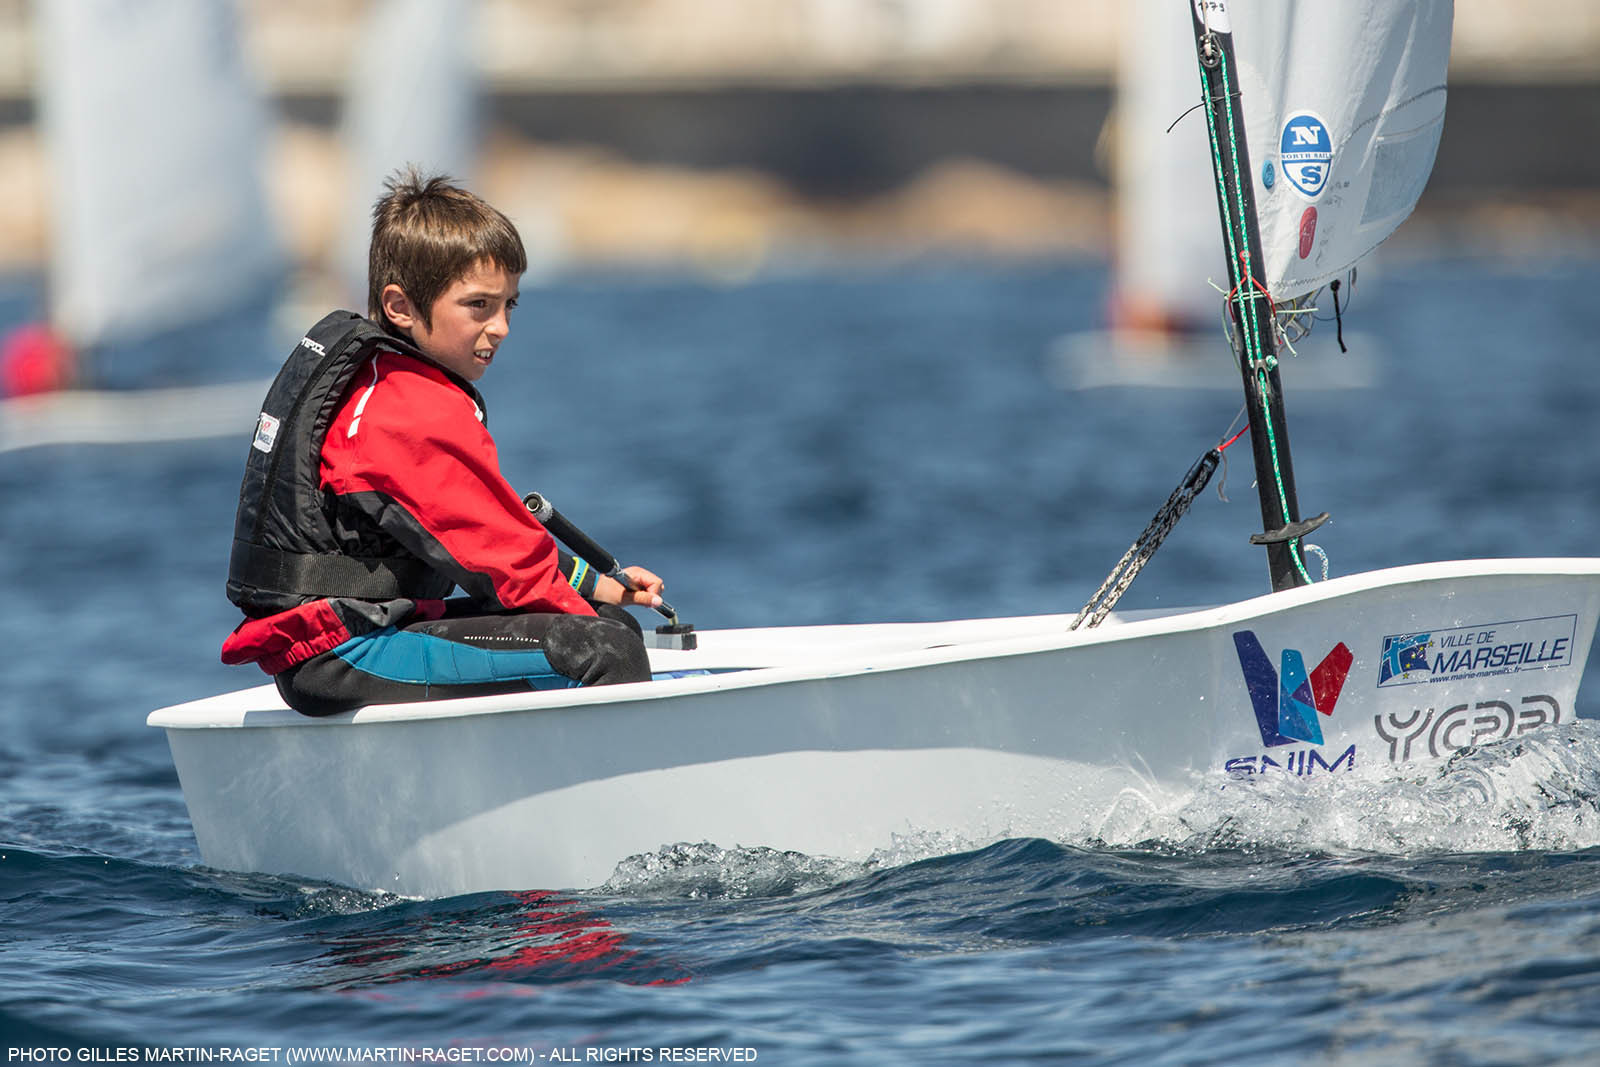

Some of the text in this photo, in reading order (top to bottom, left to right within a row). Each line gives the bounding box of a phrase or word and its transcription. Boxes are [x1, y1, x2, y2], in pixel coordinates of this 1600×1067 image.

[1290, 126, 1321, 145] N
[1301, 165, 1322, 185] S
[1440, 631, 1497, 648] VILLE DE
[1431, 637, 1569, 674] MARSEILLE
